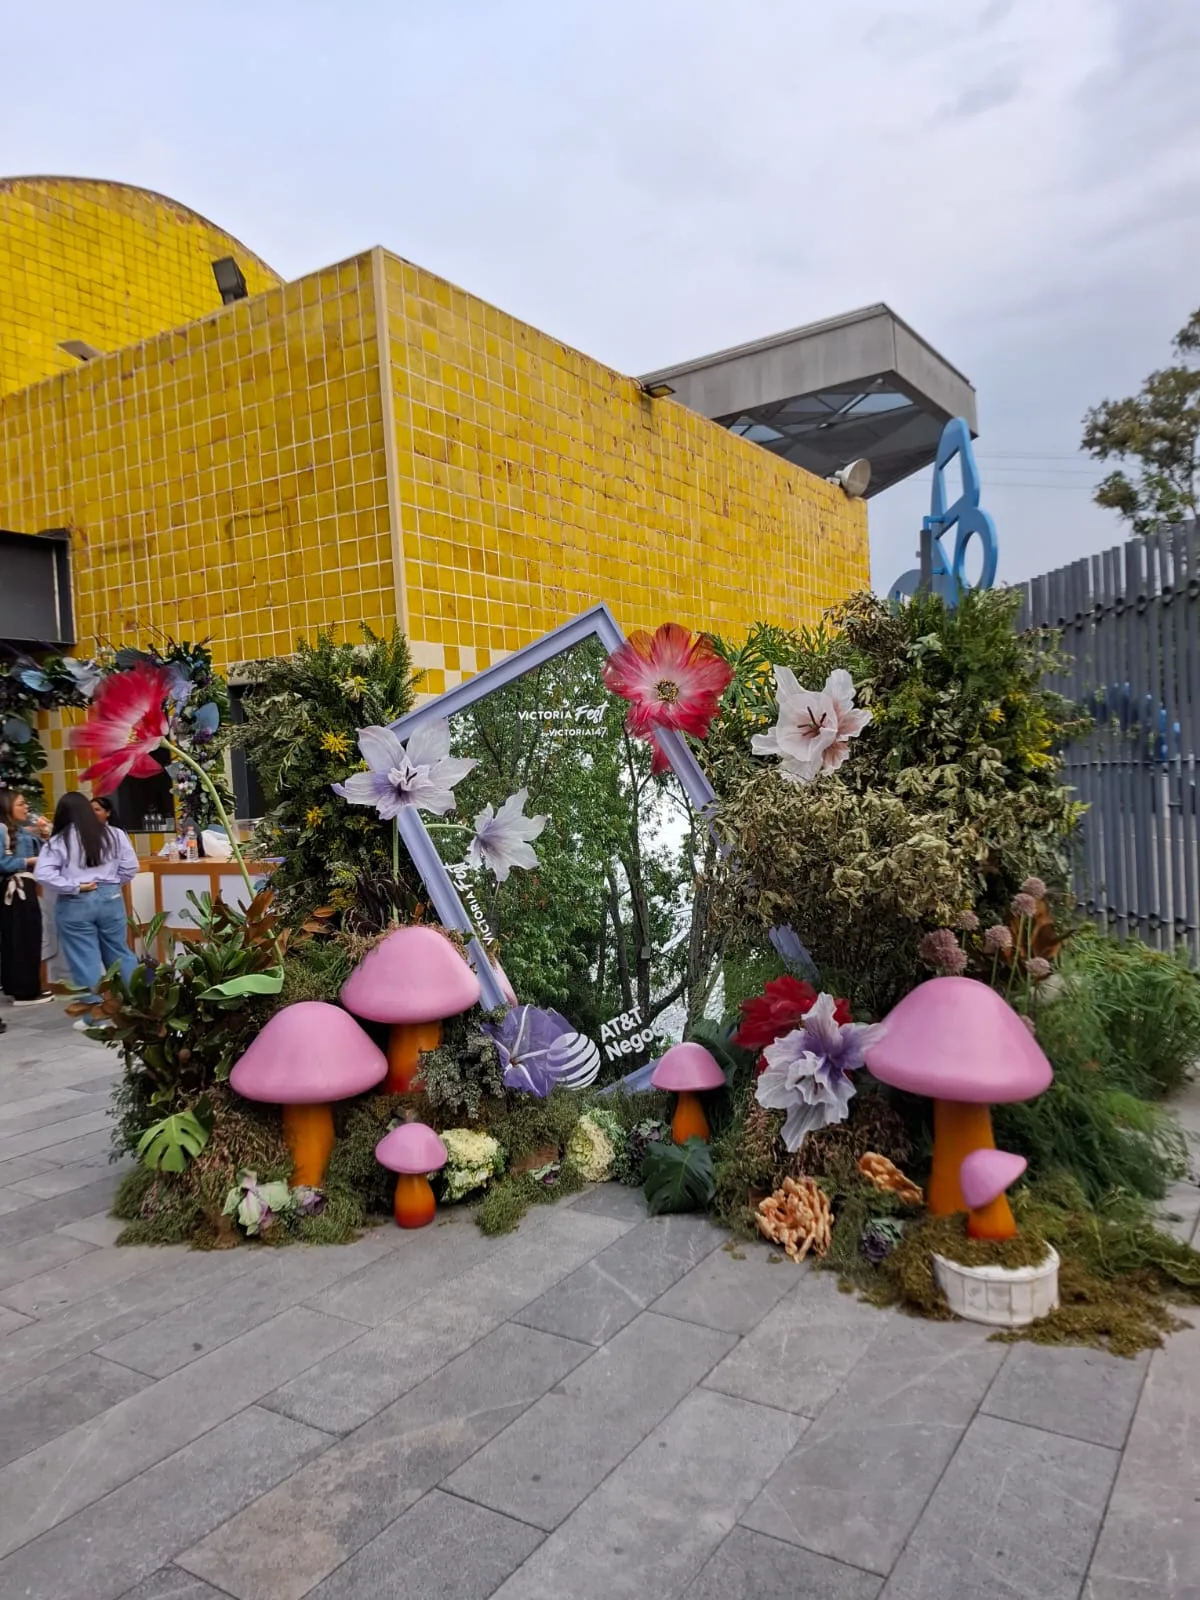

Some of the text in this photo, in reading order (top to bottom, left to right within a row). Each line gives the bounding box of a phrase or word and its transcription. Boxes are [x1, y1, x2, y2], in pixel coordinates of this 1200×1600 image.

[518, 700, 610, 724] VICTORIA Fest
[549, 726, 608, 738] VICTORIA147
[466, 890, 495, 946] VICTORIA
[600, 1006, 643, 1043] AT&T
